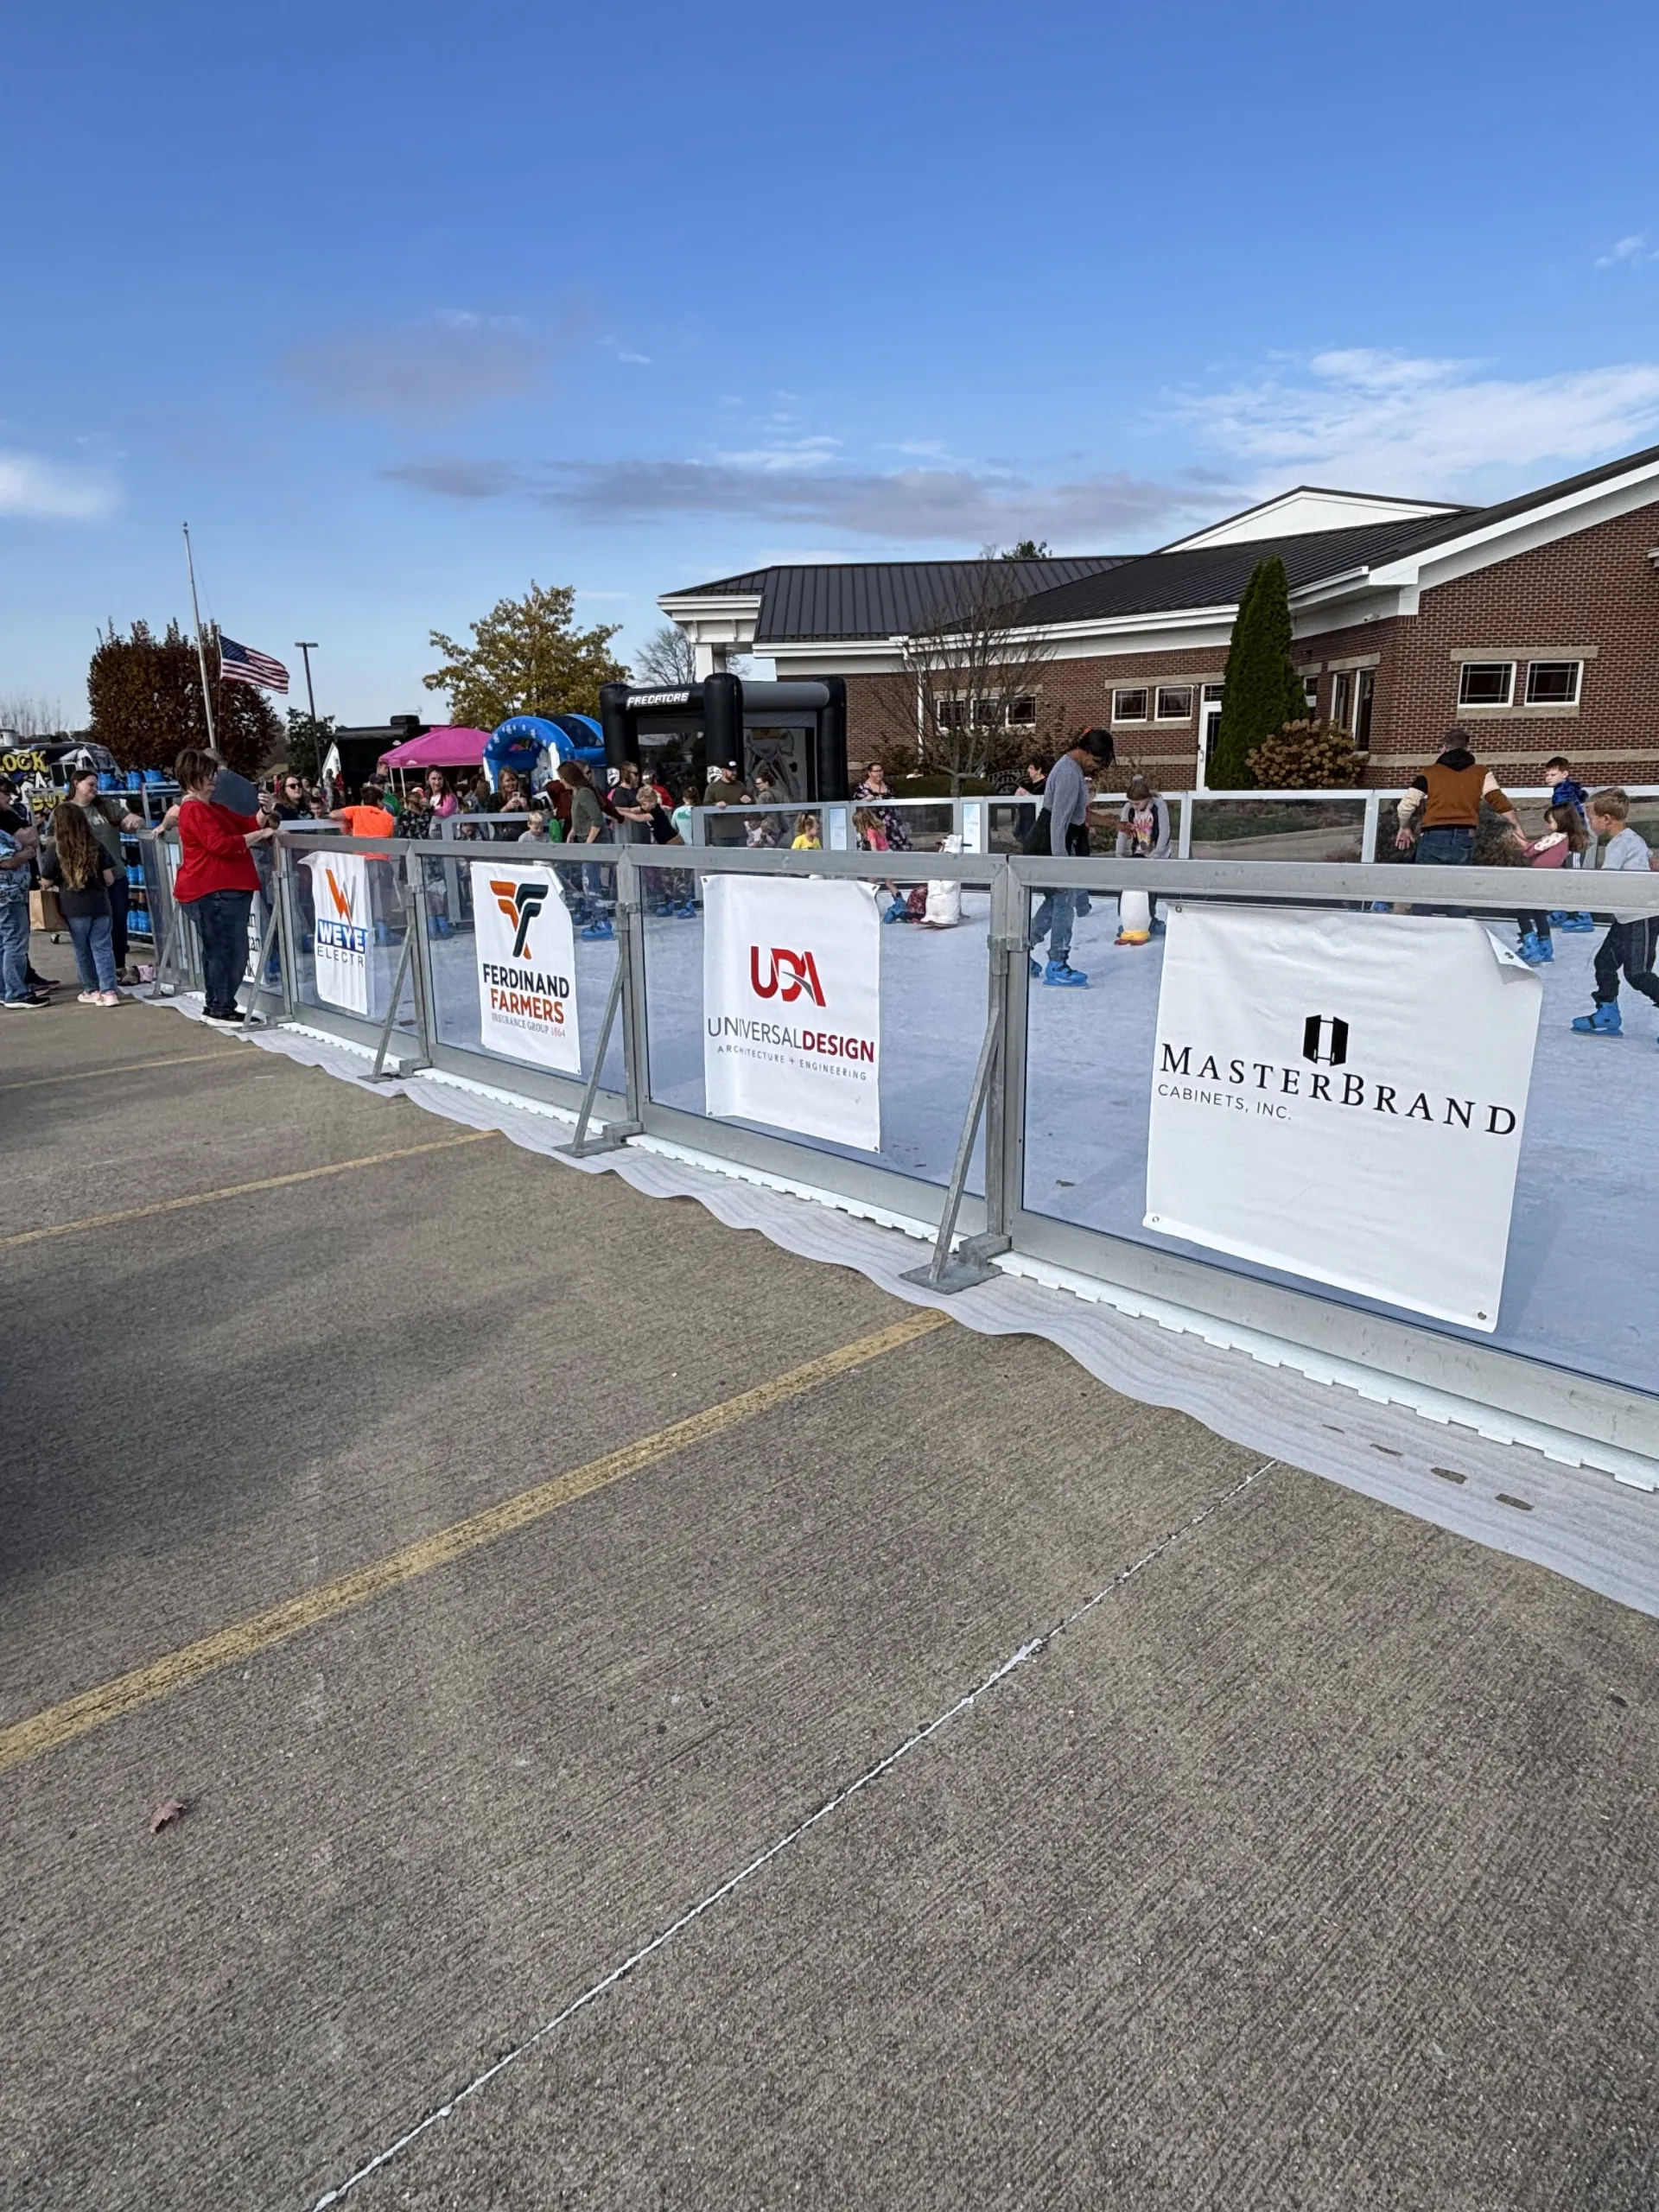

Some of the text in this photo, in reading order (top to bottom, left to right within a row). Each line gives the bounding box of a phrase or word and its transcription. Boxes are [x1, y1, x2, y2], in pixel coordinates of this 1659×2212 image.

[626, 692, 690, 710] PREDATORS
[318, 920, 369, 952] WEYE
[483, 963, 570, 999] FERDINAND
[750, 945, 827, 1008] UDA
[490, 988, 565, 1025] FARMERS
[491, 1012, 527, 1030] INSURANCE
[526, 1020, 550, 1035] GROUP
[717, 1045, 785, 1064] ARCHITECTURE
[799, 1058, 868, 1081] ENGINEERING
[1158, 1084, 1292, 1121] CABINETS, INC.
